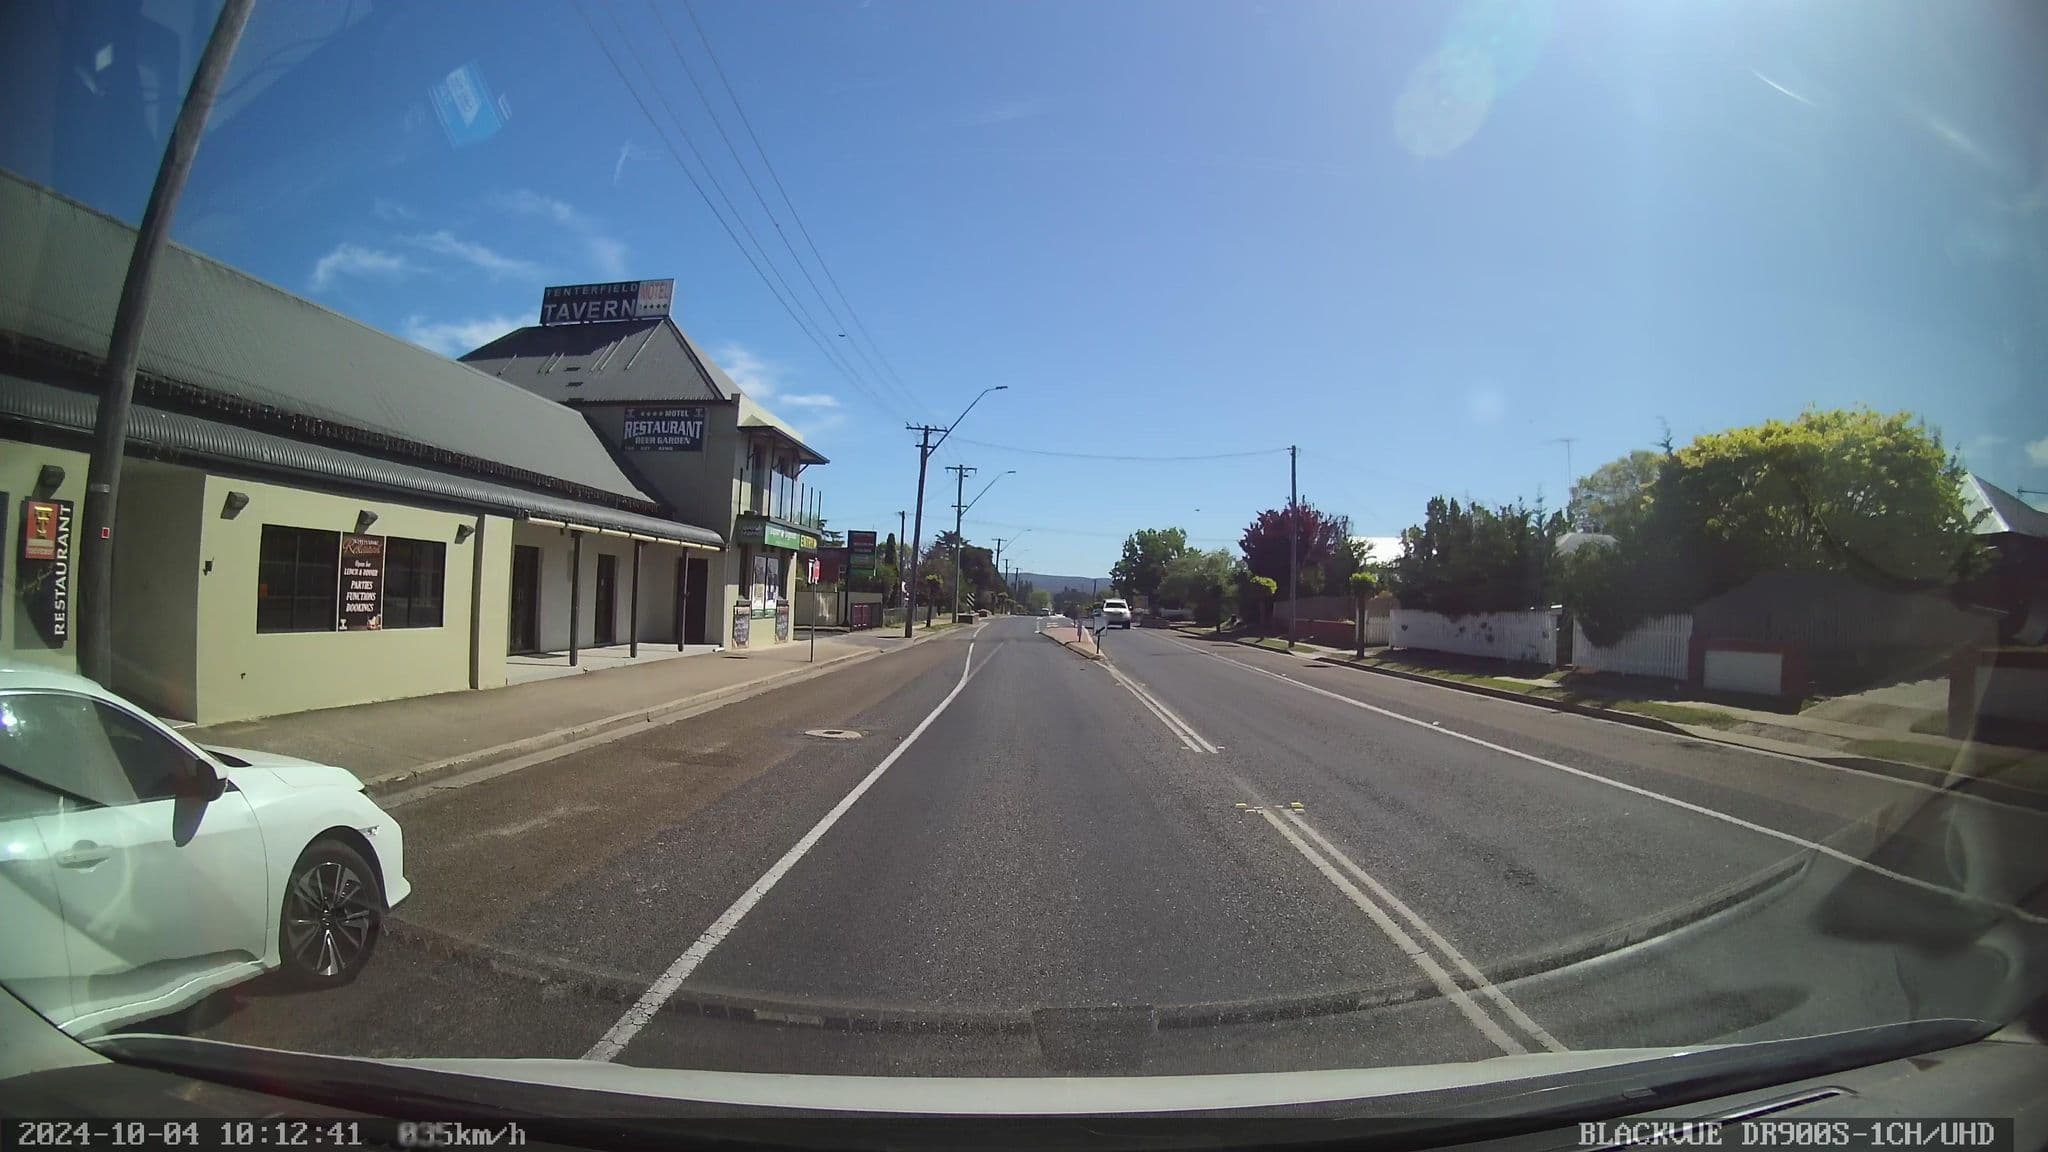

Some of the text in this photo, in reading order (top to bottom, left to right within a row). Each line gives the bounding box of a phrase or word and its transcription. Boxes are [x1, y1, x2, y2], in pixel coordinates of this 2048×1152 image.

[546, 283, 639, 297] TENTERFIELD
[543, 299, 637, 321] TAVERN
[624, 421, 703, 439] RESTAURANT
[635, 436, 691, 445] BEER GARDEN
[54, 504, 72, 636] RESTAURANT
[350, 580, 374, 590] PARTIES
[346, 591, 377, 601] FUNCTIONS
[345, 603, 375, 613] BOOKINGS
